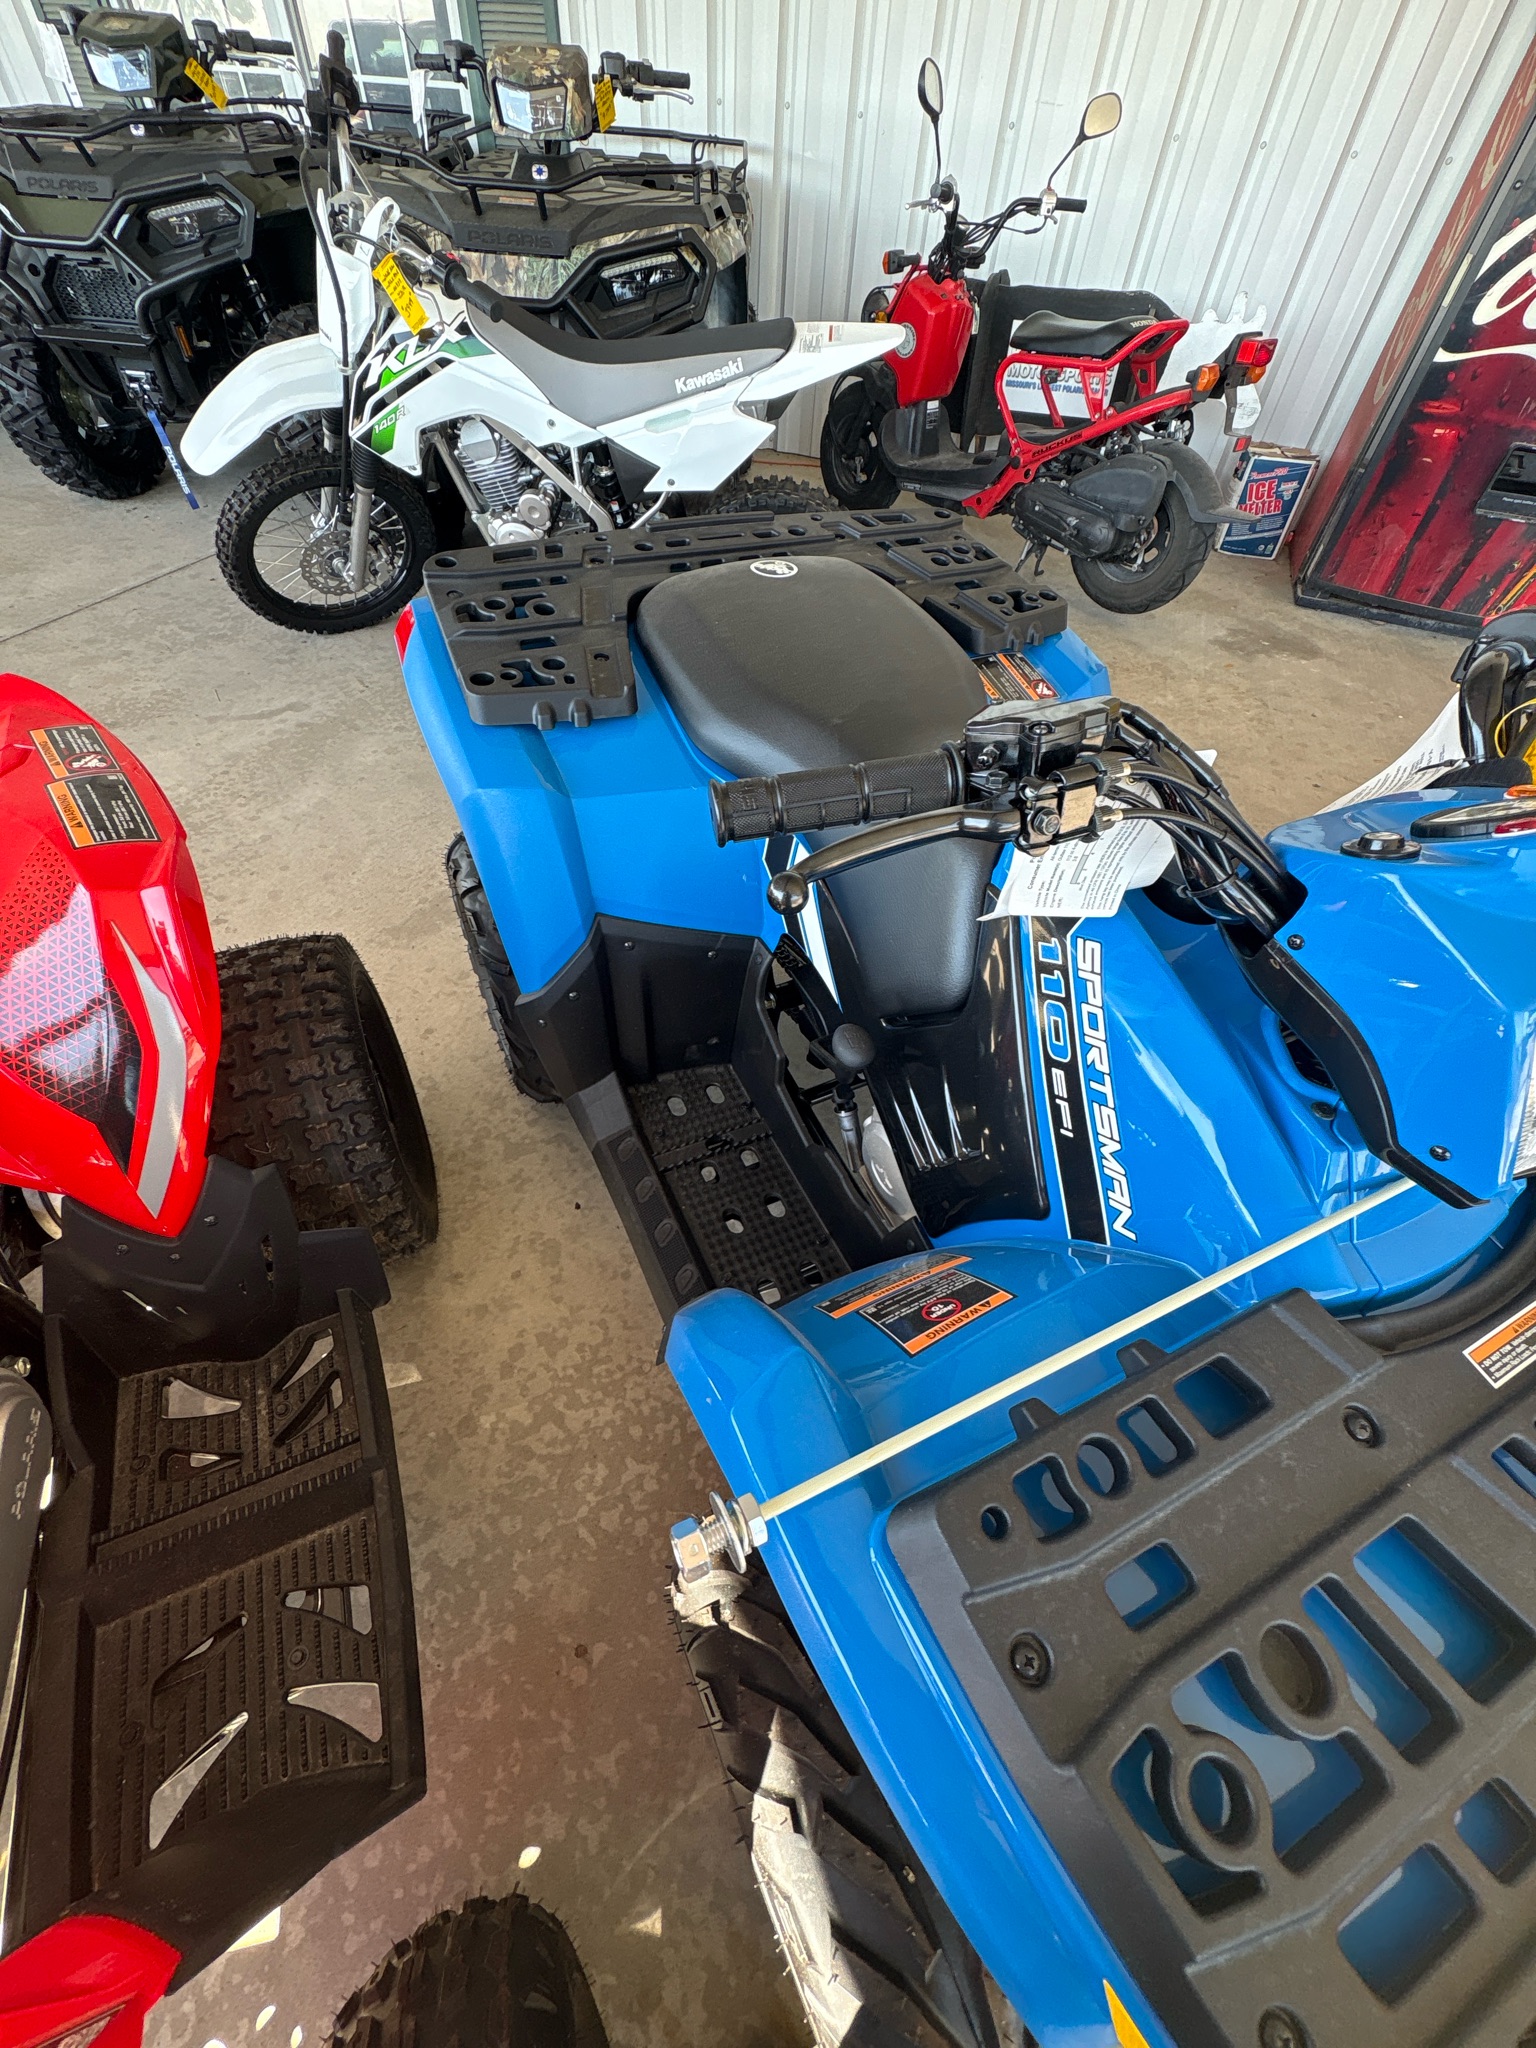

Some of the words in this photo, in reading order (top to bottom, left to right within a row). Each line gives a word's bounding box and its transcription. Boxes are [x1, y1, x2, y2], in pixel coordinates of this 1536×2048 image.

[27, 177, 99, 192] POLARIS
[467, 229, 554, 248] POLARIS
[1130, 319, 1157, 328] HONDA
[363, 310, 468, 391] KLX
[675, 357, 744, 394] Kawasaki
[1032, 433, 1083, 458] RUCKUS
[164, 445, 191, 495] POLARIS
[1246, 479, 1278, 504] ICE
[38, 741, 56, 763] WARNING
[57, 793, 78, 823] WARNING
[1038, 937, 1072, 1064] 110
[1051, 1066, 1074, 1138] EFI
[1076, 936, 1137, 1243] SPORTSMAN
[873, 1276, 918, 1297] WARNING
[929, 1303, 957, 1319] UNDER
[931, 1303, 945, 1312] 10
[925, 1304, 984, 1340] WARNING
